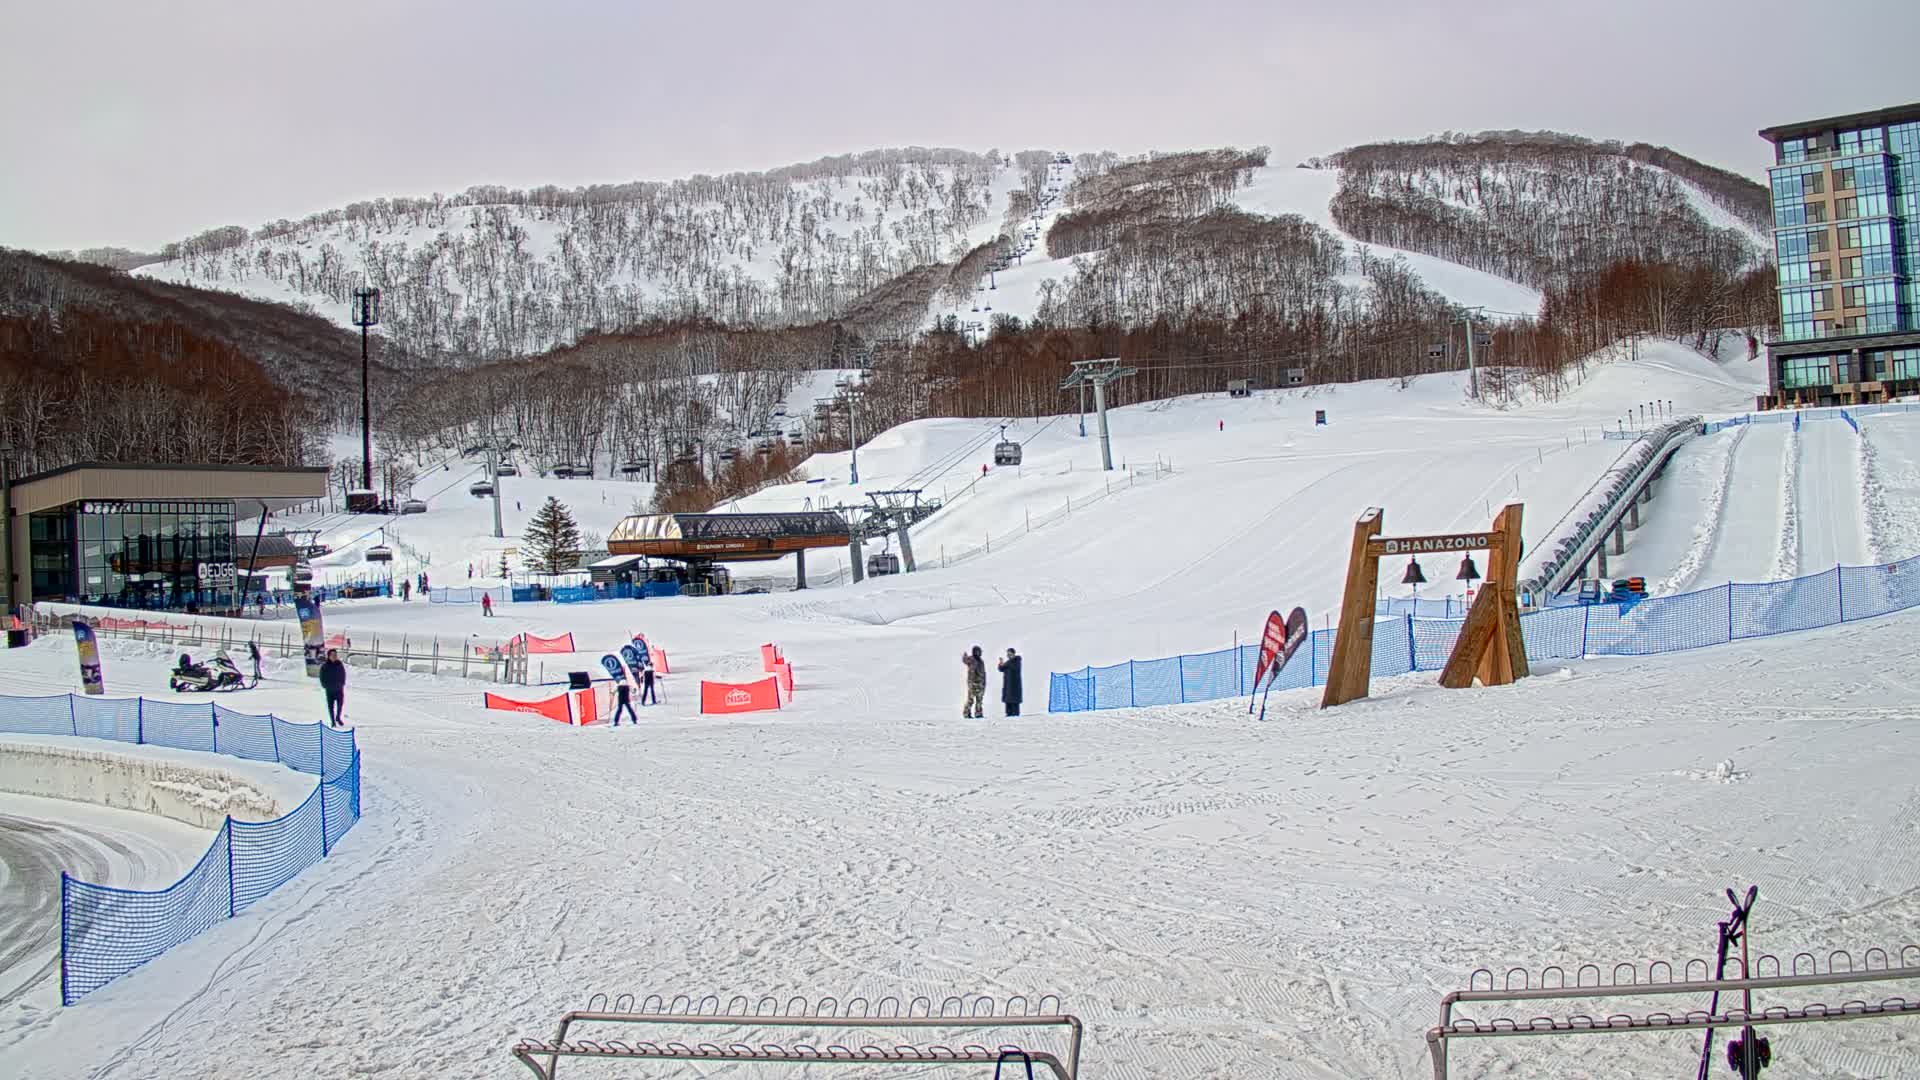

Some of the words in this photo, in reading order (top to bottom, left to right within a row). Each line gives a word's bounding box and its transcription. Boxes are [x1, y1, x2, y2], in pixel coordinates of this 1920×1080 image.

[1400, 536, 1488, 551] HANAZONO
[207, 562, 234, 578] EDGE
[727, 694, 750, 704] NISS
